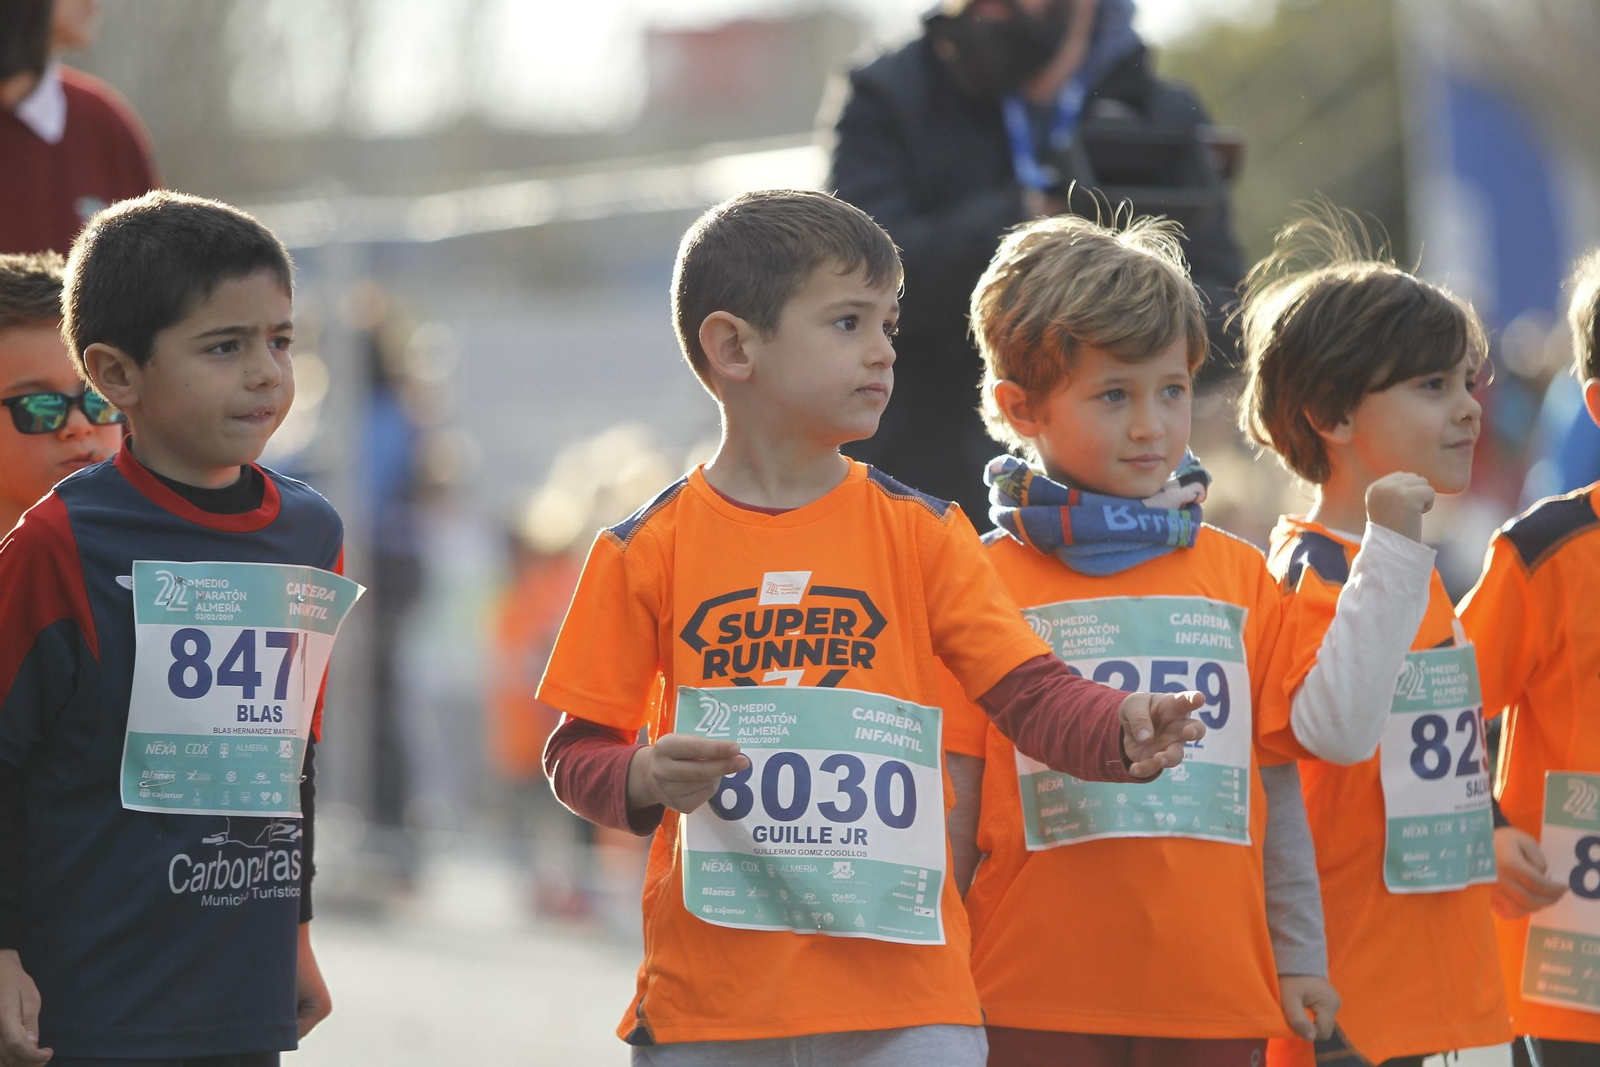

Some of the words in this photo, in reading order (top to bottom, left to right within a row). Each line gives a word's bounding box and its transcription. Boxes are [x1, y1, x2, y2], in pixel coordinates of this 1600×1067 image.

[195, 578, 229, 589] MEDIO
[195, 589, 247, 601] MARATÓN
[195, 601, 242, 613] ALMERÍA
[194, 613, 234, 621] 03/02/2019
[1060, 614, 1098, 627] MEDIO
[1170, 613, 1231, 631] CARRERA
[717, 607, 857, 644] SUPER
[1061, 622, 1120, 638] MARATÓN
[1062, 634, 1115, 649] ALMERÍA
[1175, 631, 1234, 649] INFANTIL
[702, 638, 876, 679] RUNNER
[1430, 664, 1460, 675] MEDIO
[237, 704, 283, 723] BLAS
[739, 703, 776, 713] MEDIO
[738, 712, 797, 725] MARATÓN
[852, 707, 922, 734] CARRERA
[213, 727, 231, 735] BLAS
[232, 727, 272, 736] HERNANDEZ
[737, 724, 790, 736] ALMERÍA
[737, 736, 780, 744] 03/02/2019
[855, 726, 923, 753] INFANTIL
[145, 742, 177, 755] NEXA
[185, 742, 212, 755] CDX
[235, 742, 268, 752] ALMERÍA
[707, 751, 917, 829] 8030
[1037, 777, 1064, 793] NEXA
[151, 790, 184, 800] cajamar
[752, 825, 832, 844] GUILLE
[839, 827, 868, 846] JR
[753, 848, 796, 856] GUILLERMO
[798, 849, 823, 857] GOMIZ
[824, 849, 868, 858] COGOLLOS
[702, 861, 733, 873] NEXA
[741, 861, 760, 873] CDX
[780, 863, 818, 873] ALMERÍA
[702, 887, 736, 897] Blanes
[714, 906, 746, 916] cajamar
